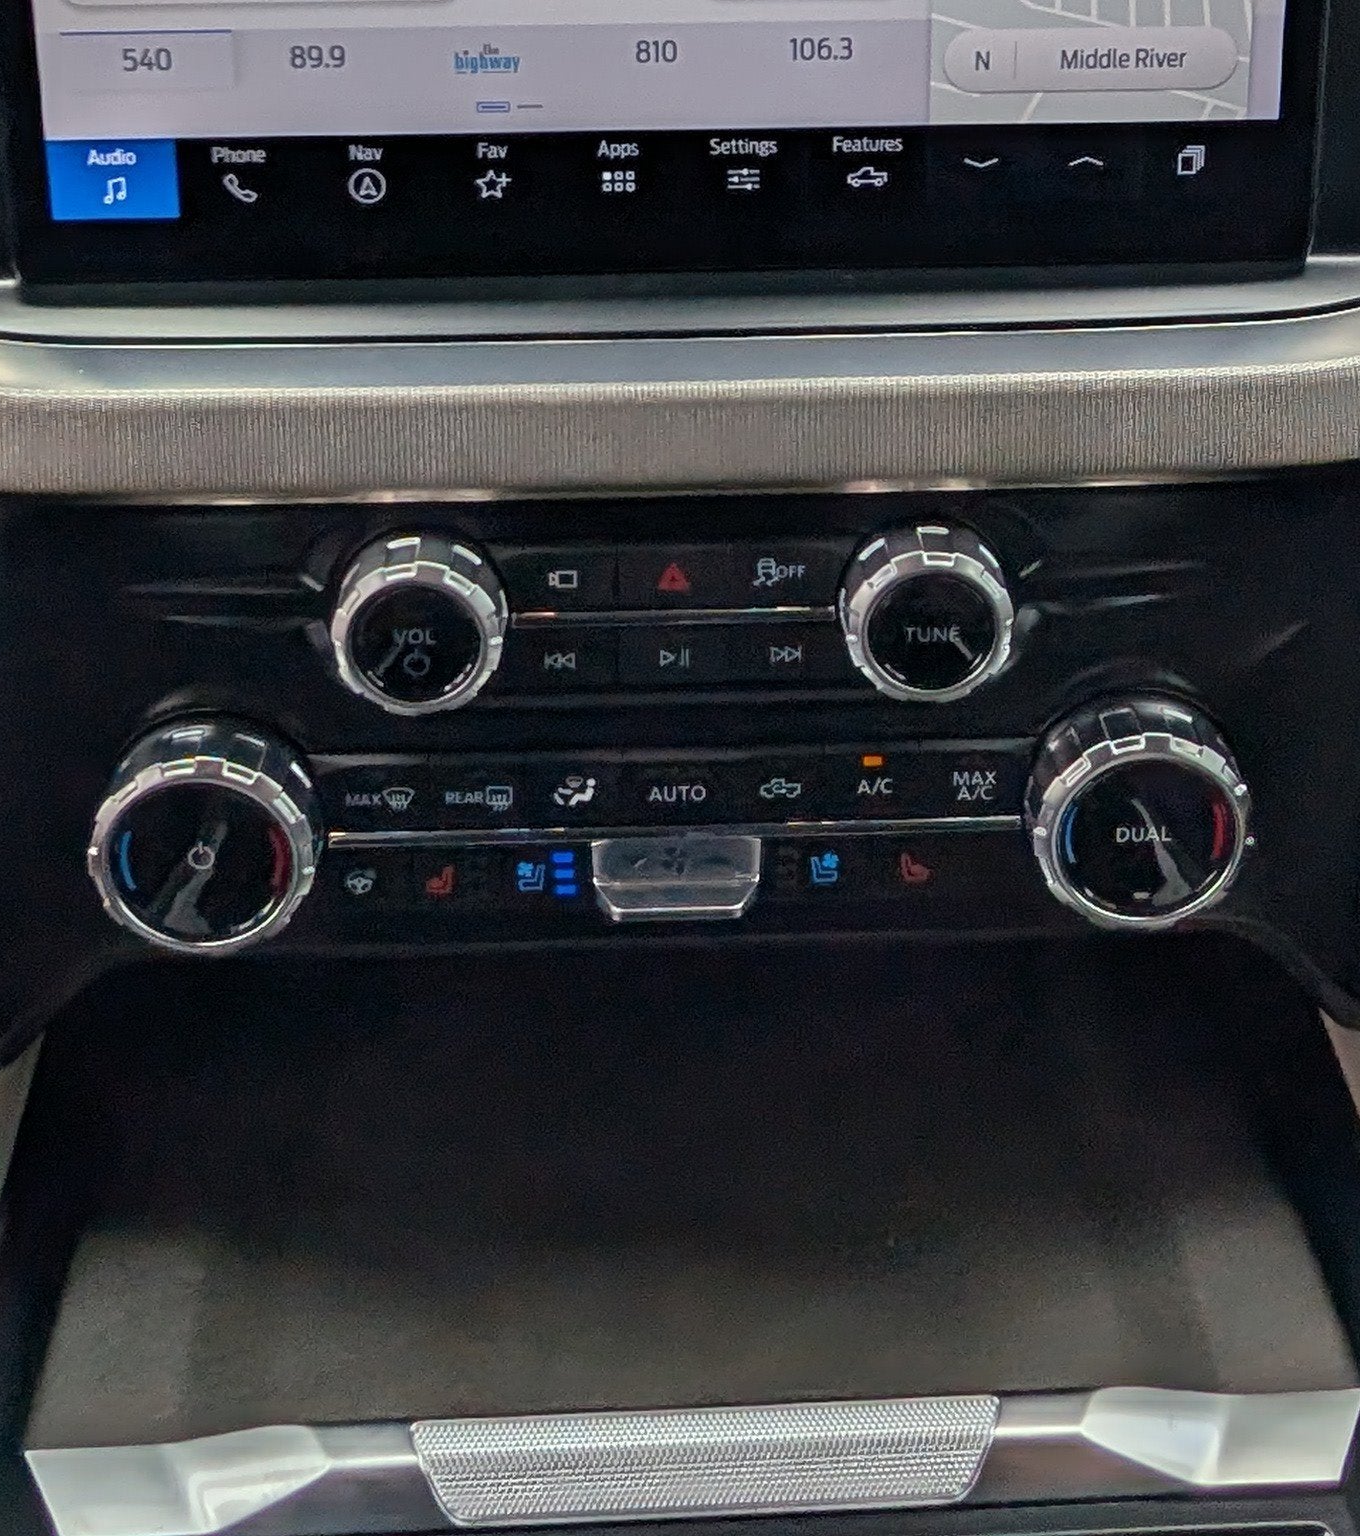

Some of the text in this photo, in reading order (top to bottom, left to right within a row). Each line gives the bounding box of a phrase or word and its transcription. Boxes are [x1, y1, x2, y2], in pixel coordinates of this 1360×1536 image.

[289, 44, 347, 70] 89.9
[635, 38, 678, 64] 810
[789, 37, 854, 62] 106.3
[1059, 46, 1187, 70] Middle River
[122, 47, 173, 73] 540
[973, 51, 991, 71] N
[349, 143, 383, 163] Nav
[477, 141, 509, 159] Fav
[597, 140, 640, 161] Apps
[709, 137, 778, 157] Settings
[832, 135, 904, 154] Features
[87, 147, 137, 167] Audio
[211, 145, 267, 164] Phone
[776, 563, 806, 580] OFF
[392, 627, 437, 646] VOL
[904, 625, 961, 643] TUNE
[856, 776, 894, 796] A/C
[952, 770, 997, 786] MAX
[344, 792, 382, 807] MAX
[444, 790, 484, 806] REAR
[648, 785, 707, 803] AUTO
[956, 784, 995, 802] A/C
[1115, 825, 1173, 844] DUAL
